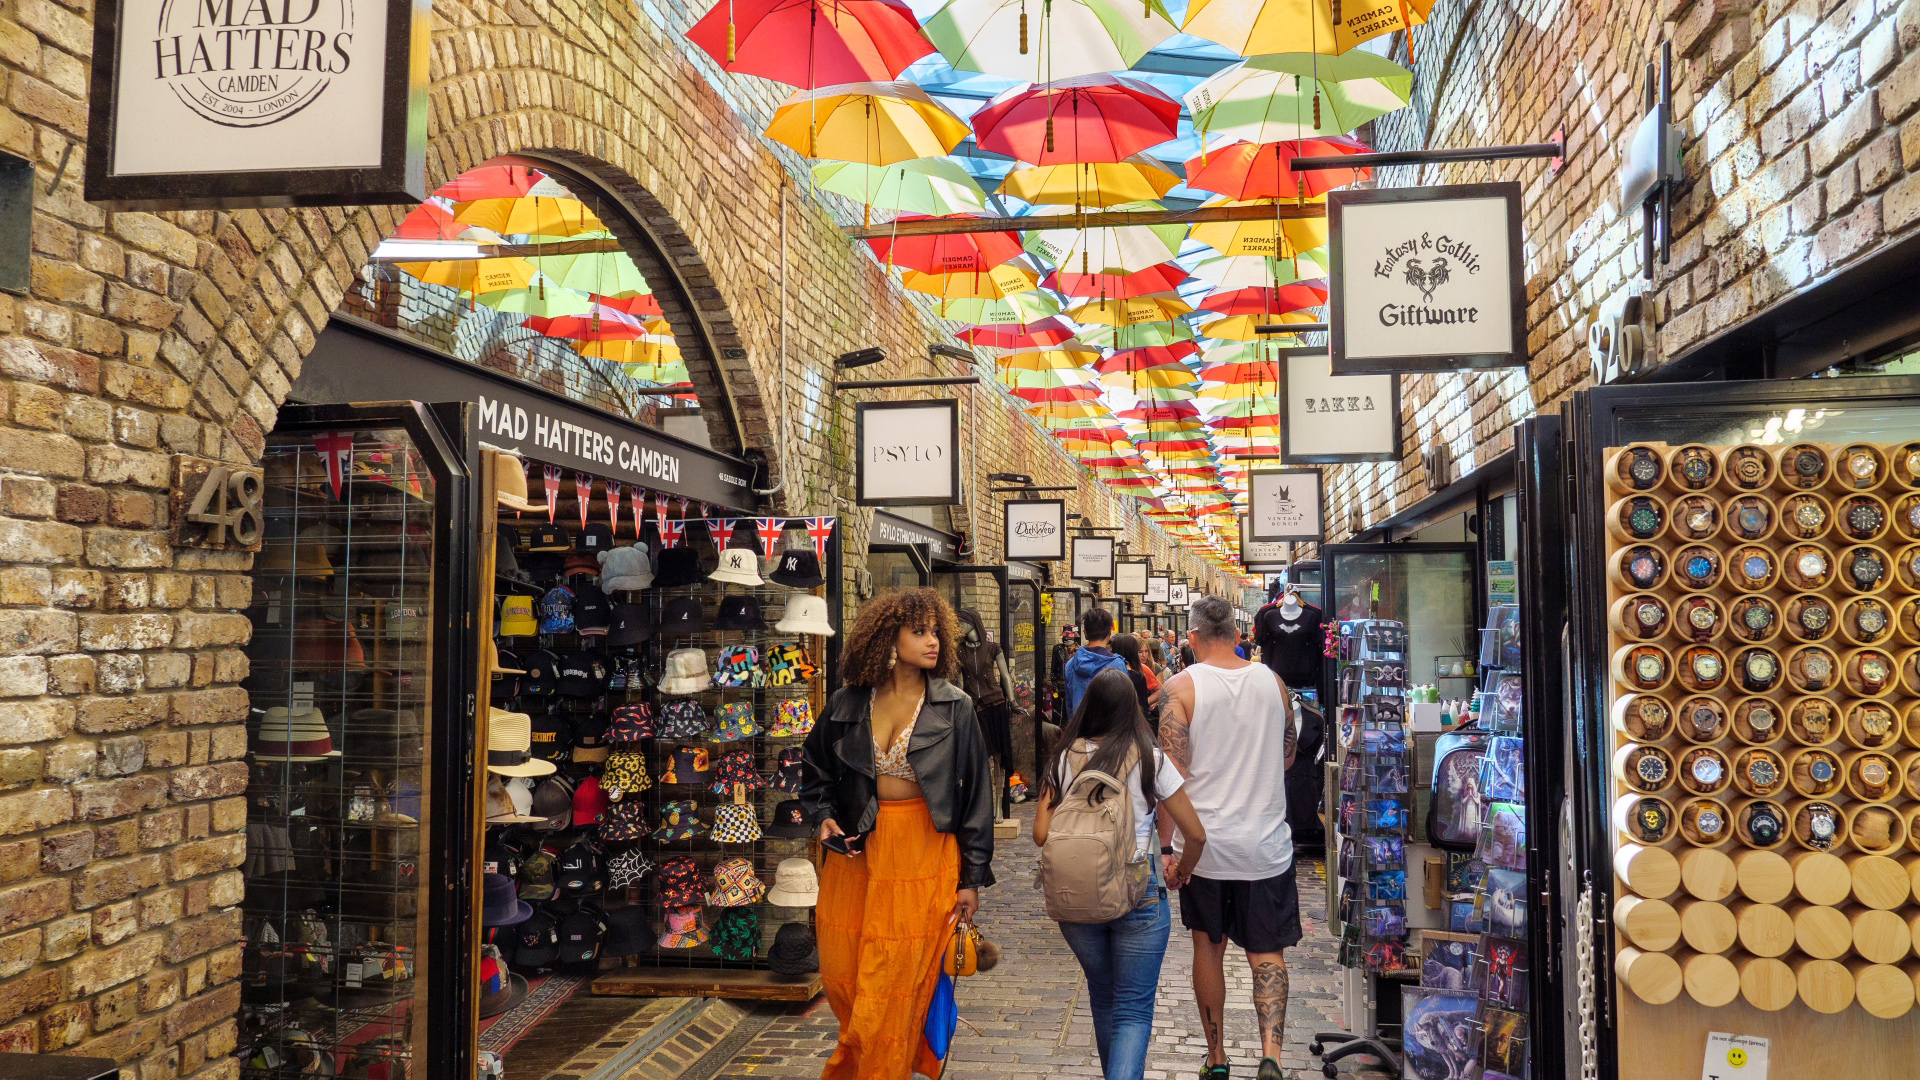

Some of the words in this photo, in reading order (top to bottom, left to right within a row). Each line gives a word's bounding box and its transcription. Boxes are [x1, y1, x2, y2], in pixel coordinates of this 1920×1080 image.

[192, 0, 320, 28] MAD
[152, 28, 354, 80] HATTERS
[218, 75, 279, 93] CAMDEN
[222, 104, 244, 115] 2004
[258, 90, 299, 114] LONDON
[1374, 238, 1418, 279] Fantasy
[1420, 231, 1433, 250] &
[1435, 235, 1481, 275] Gothic
[485, 272, 511, 281] CAMDEN
[488, 279, 514, 288] MARKET
[1378, 303, 1479, 327] Giftware
[1305, 395, 1375, 413] ZAKKA
[479, 396, 528, 441] MAD
[535, 413, 614, 466] HATTERS
[618, 441, 679, 484] CAMDEN
[873, 444, 942, 462] PSYLO
[187, 466, 265, 545] 48
[880, 522, 897, 541] PSYLO
[531, 731, 557, 743] SECURITY
